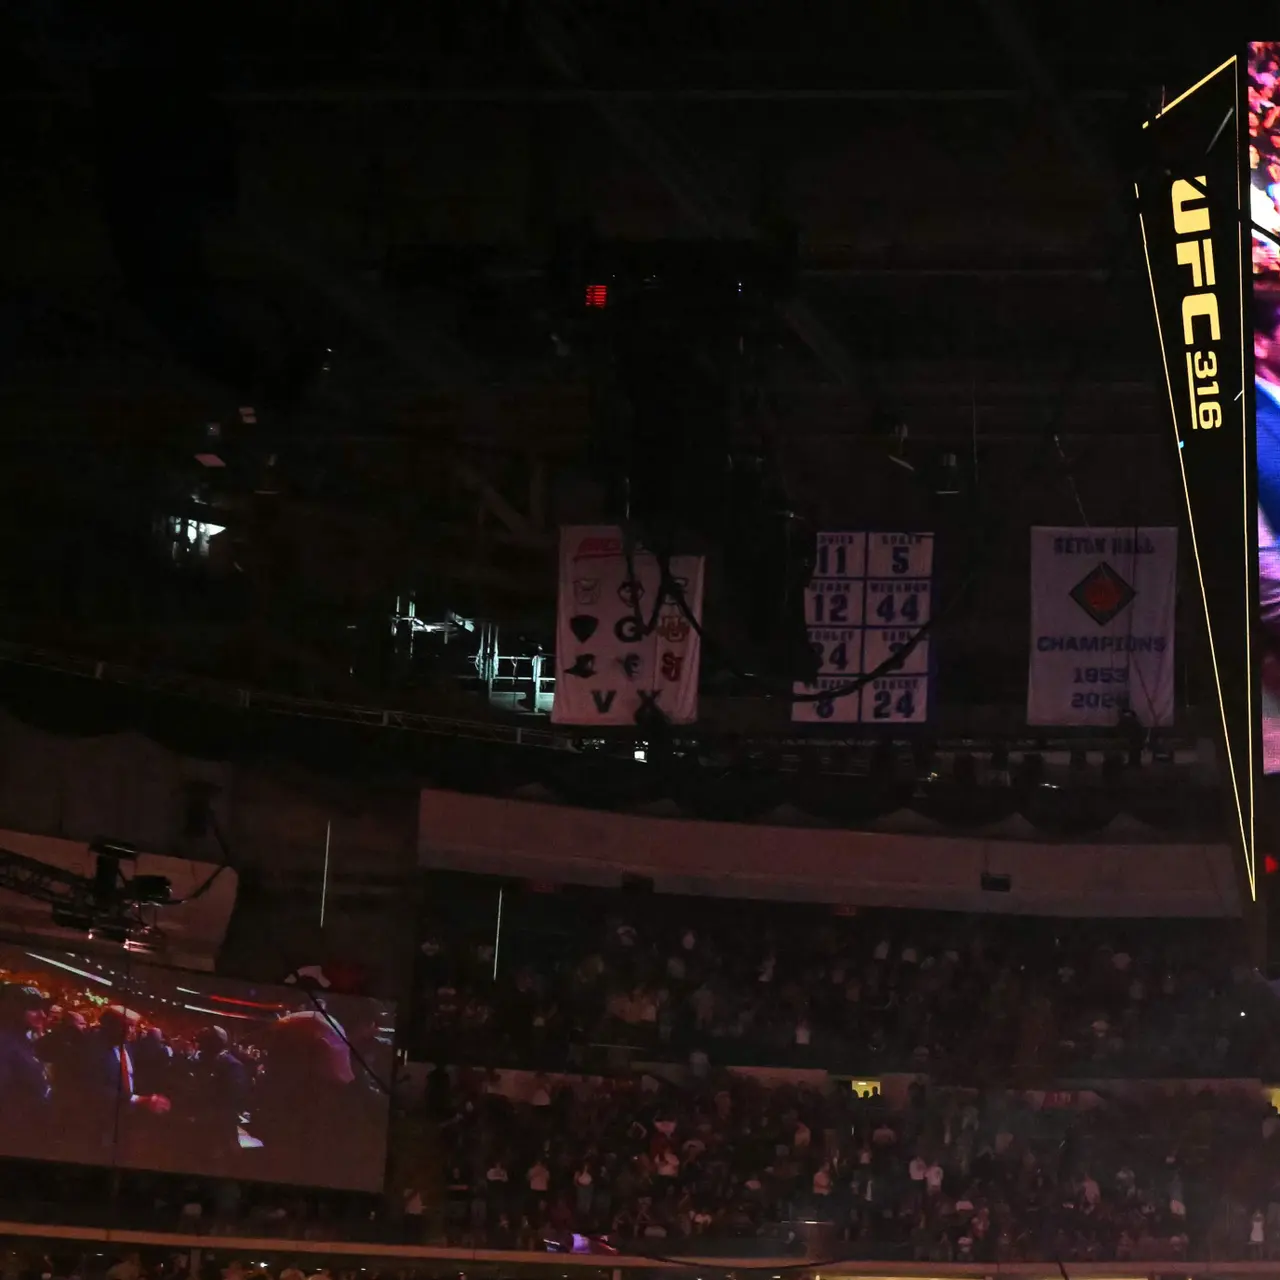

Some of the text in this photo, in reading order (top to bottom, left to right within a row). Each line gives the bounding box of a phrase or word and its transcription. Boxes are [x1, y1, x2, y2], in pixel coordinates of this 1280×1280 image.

[1171, 175, 1222, 430] UFC 316
[818, 545, 847, 574] 11
[891, 546, 909, 574] 5
[813, 594, 848, 622] 12
[876, 594, 919, 622] 44
[1037, 635, 1167, 652] CHAMPIONS
[873, 690, 915, 718] 24
